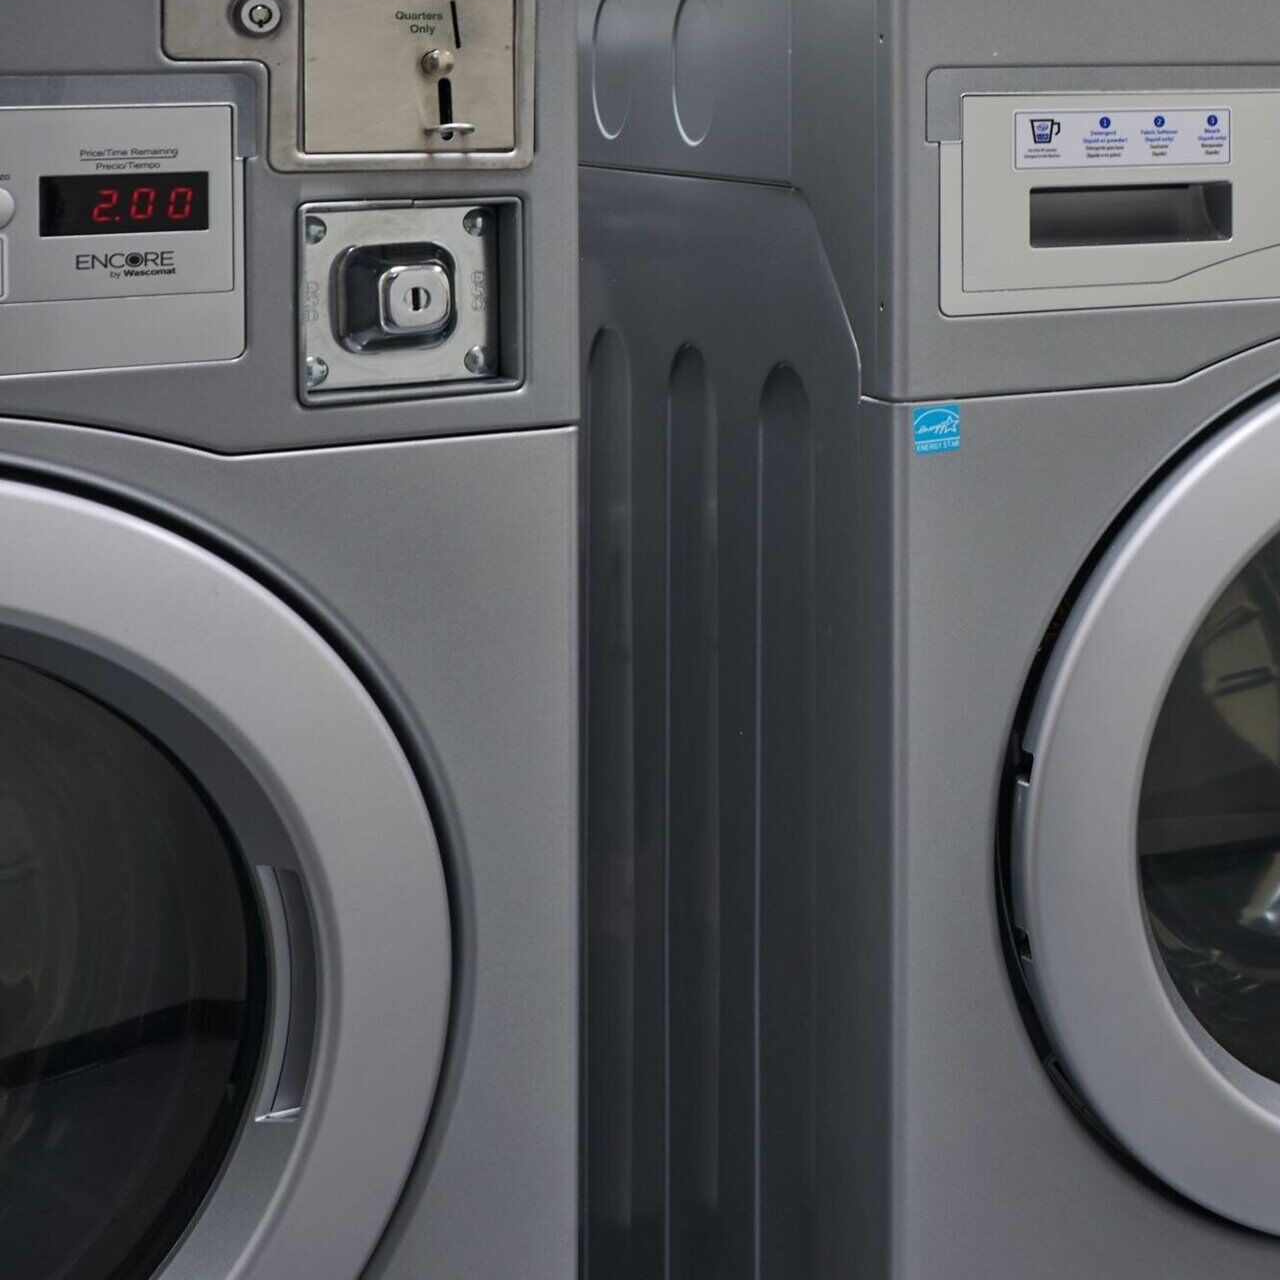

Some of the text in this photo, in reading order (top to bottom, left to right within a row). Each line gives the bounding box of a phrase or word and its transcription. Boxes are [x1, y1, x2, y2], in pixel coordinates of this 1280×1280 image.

[395, 11, 443, 20] Quarters
[410, 24, 435, 35] Only
[80, 147, 178, 157] Price/Time Remaining
[96, 161, 160, 170] Precio/Tiempo
[92, 187, 193, 222] 2.00
[76, 251, 174, 270] ENCORE
[110, 267, 176, 279] by Wascomat
